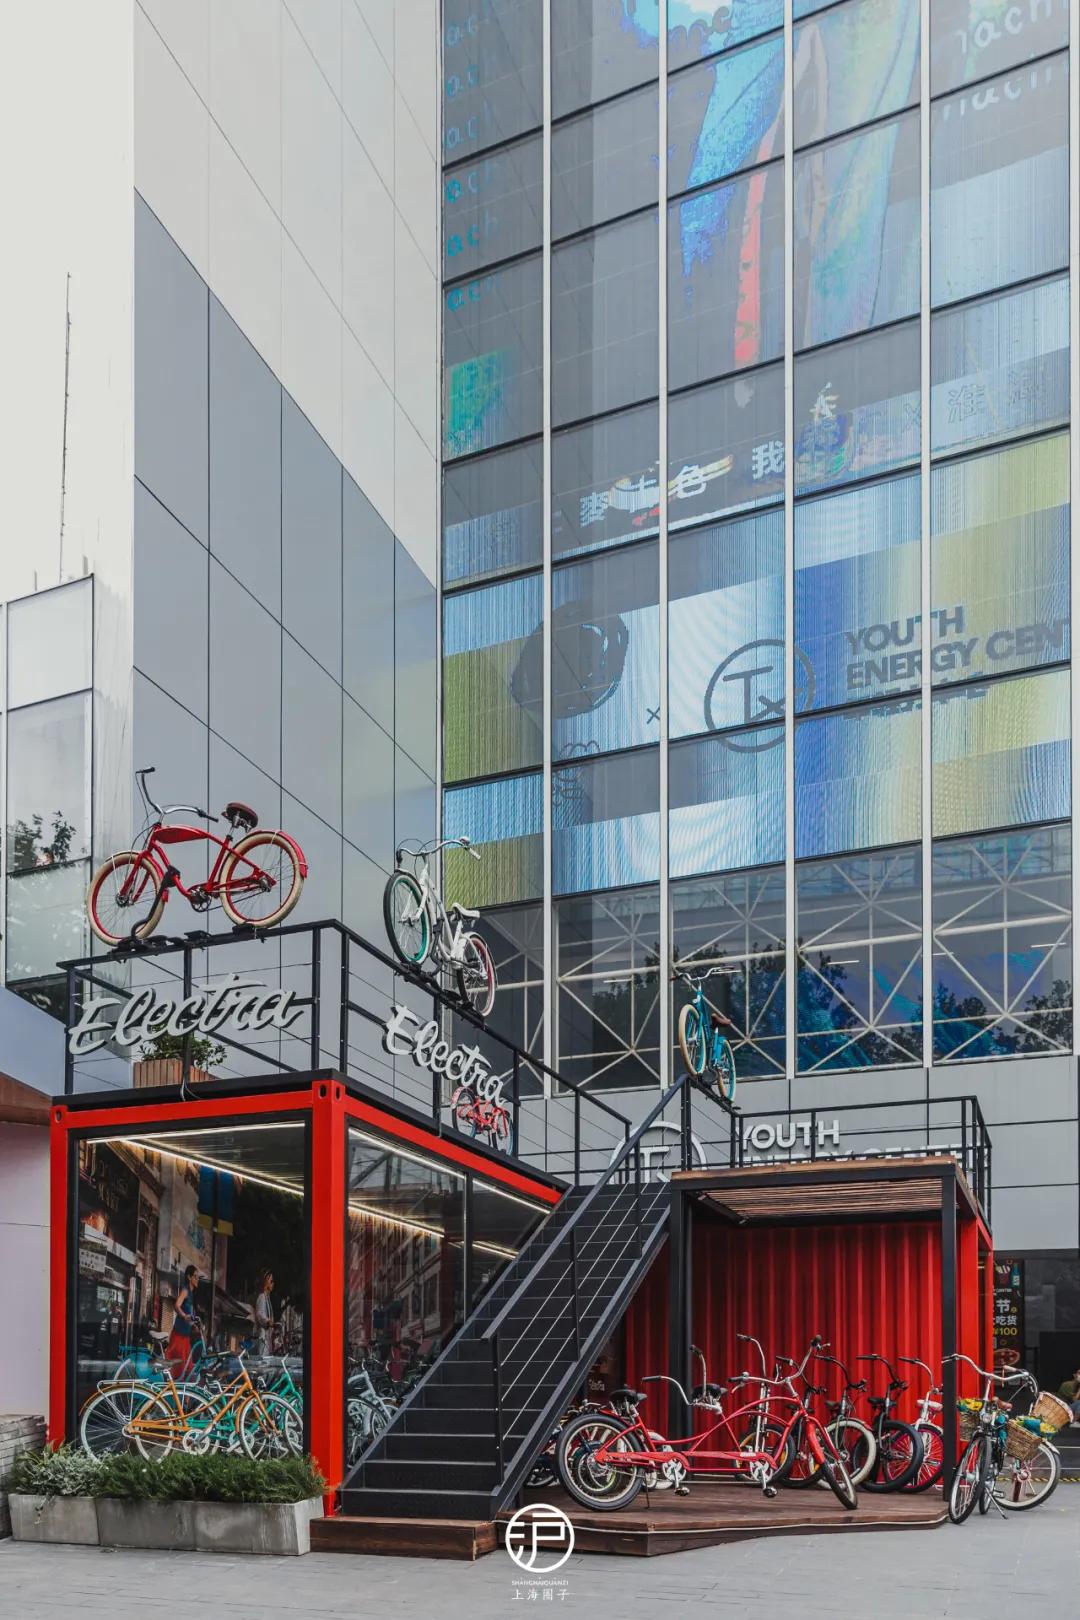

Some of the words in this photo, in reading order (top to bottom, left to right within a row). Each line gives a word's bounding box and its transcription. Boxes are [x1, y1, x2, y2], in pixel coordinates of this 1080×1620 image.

[69, 974, 303, 1055] Electra
[384, 1005, 507, 1107] Electra
[736, 1119, 840, 1151] YOUTH
